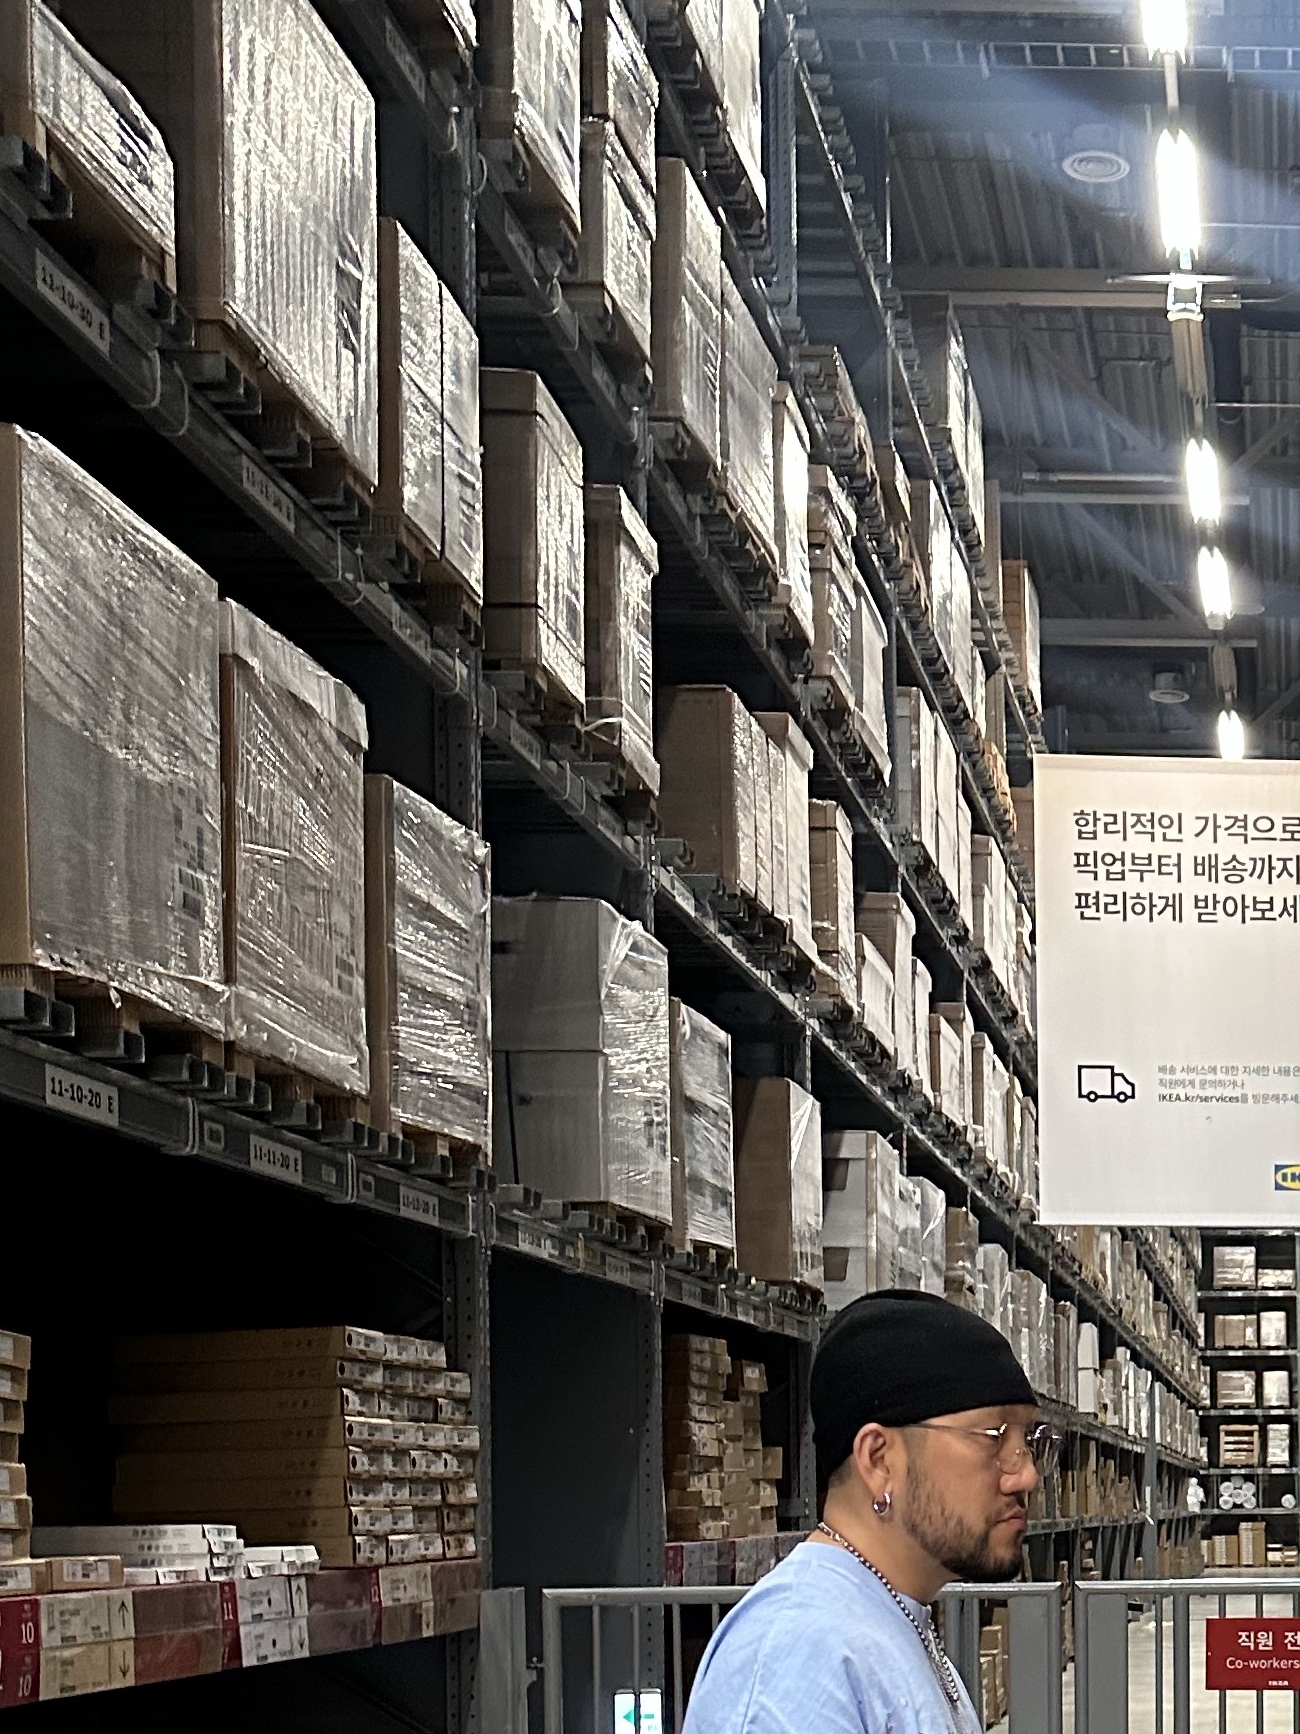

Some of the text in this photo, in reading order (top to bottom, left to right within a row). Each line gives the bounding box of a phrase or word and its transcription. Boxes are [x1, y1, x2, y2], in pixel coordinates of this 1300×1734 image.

[1073, 809, 1184, 843] 합리적인
[1073, 850, 1300, 885] 픽업부터 배송까지
[1074, 890, 1183, 923] 편리하게
[1220, 1065, 1240, 1077] 대한
[1242, 1065, 1271, 1077] 자세한
[49, 1075, 115, 1114] 11-10-20 E
[21, 1621, 35, 1645] 10
[1237, 1630, 1274, 1651] 직원
[1226, 1656, 1300, 1670] Co-workers
[18, 1673, 32, 1698] 10
